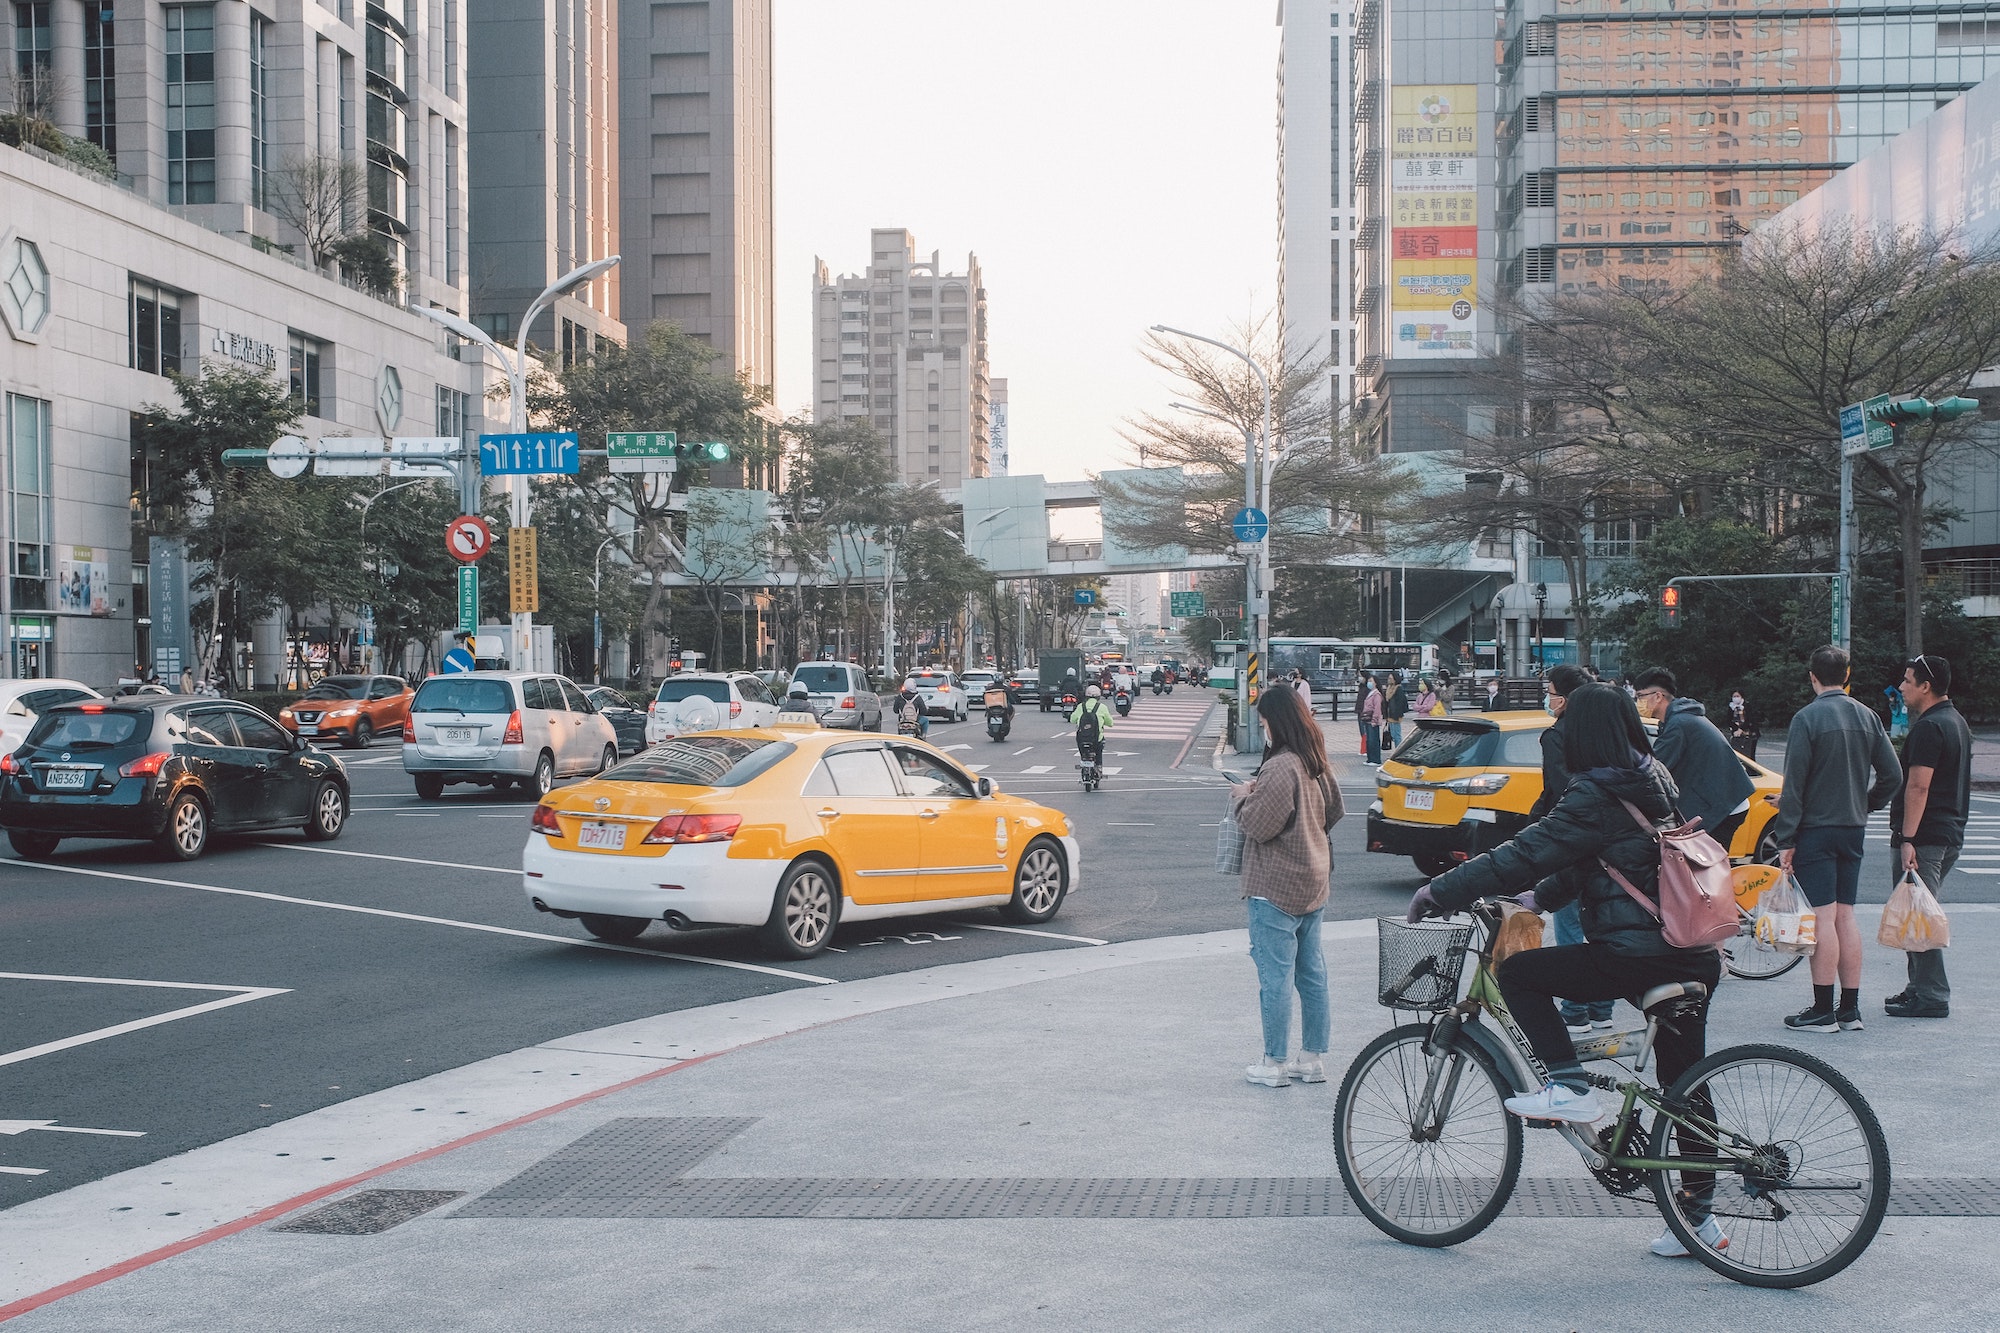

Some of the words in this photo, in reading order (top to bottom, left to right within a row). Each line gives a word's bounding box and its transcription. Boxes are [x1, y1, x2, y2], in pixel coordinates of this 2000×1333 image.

[1397, 127, 1473, 143] 麗寶百貨
[1398, 198, 1473, 210] 美食新殿堂
[1399, 231, 1439, 256] 藝奇
[1454, 304, 1469, 317] 5F
[616, 435, 667, 446] 新府路
[780, 713, 808, 723] TAXI
